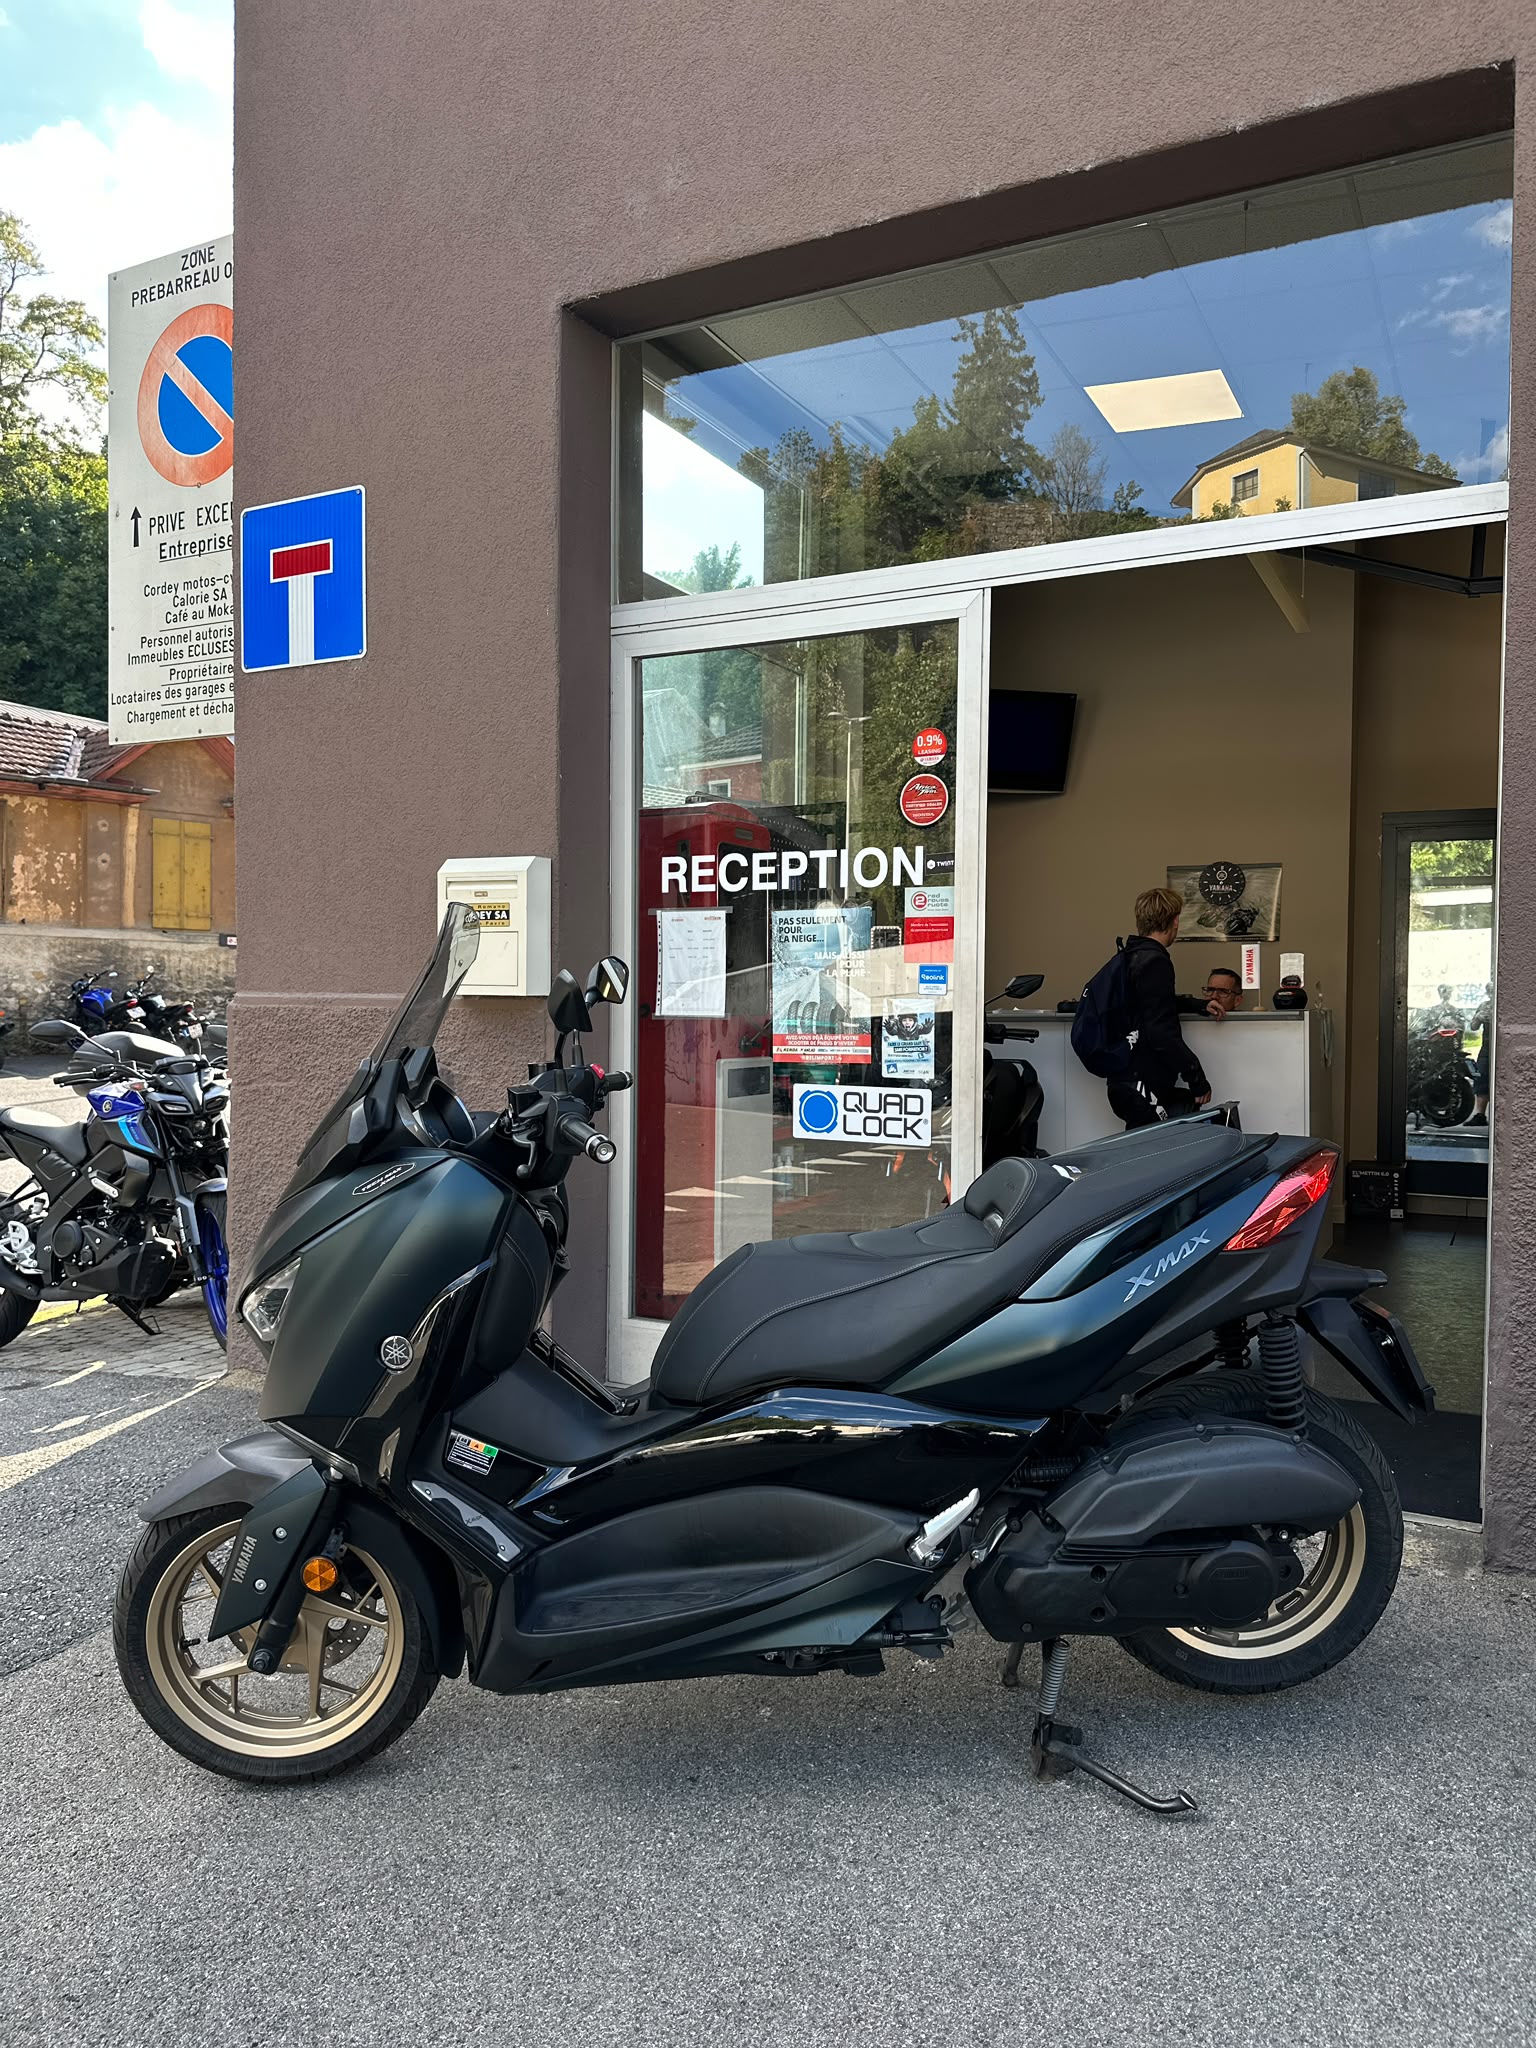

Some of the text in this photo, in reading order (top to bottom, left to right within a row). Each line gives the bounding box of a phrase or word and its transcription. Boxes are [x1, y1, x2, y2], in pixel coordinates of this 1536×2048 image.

[181, 246, 215, 271] ZONE
[131, 265, 219, 307] PREBARREAU
[149, 511, 185, 536] PRIVE
[159, 533, 233, 559] Entreprise
[143, 582, 179, 597] Cordey
[172, 588, 227, 607] Calorie SA
[165, 603, 234, 624] Café au Moka
[140, 630, 192, 649] Personnel
[127, 639, 234, 666] Immeubles ECLUSES
[169, 662, 234, 683] Propriétaire
[111, 690, 162, 705] Locataires
[164, 687, 182, 699] des
[185, 682, 225, 700] garages
[127, 701, 234, 724] Chargement et décha
[917, 734, 943, 747] 0.9%
[918, 747, 942, 755] LEASING
[661, 845, 924, 893] RECEPTION
[936, 859, 955, 867] TWINT
[1209, 884, 1233, 892] YAMAHA
[494, 910, 508, 920] SA
[778, 916, 847, 925] PAS SEULEMENT
[778, 926, 802, 934] POUR
[778, 935, 790, 943] LA
[840, 960, 865, 968] POUR
[1246, 948, 1254, 977] YAMAHA
[826, 969, 839, 977] LA
[843, 1091, 924, 1116] QUAD
[231, 1535, 258, 1584] YAMAHA
